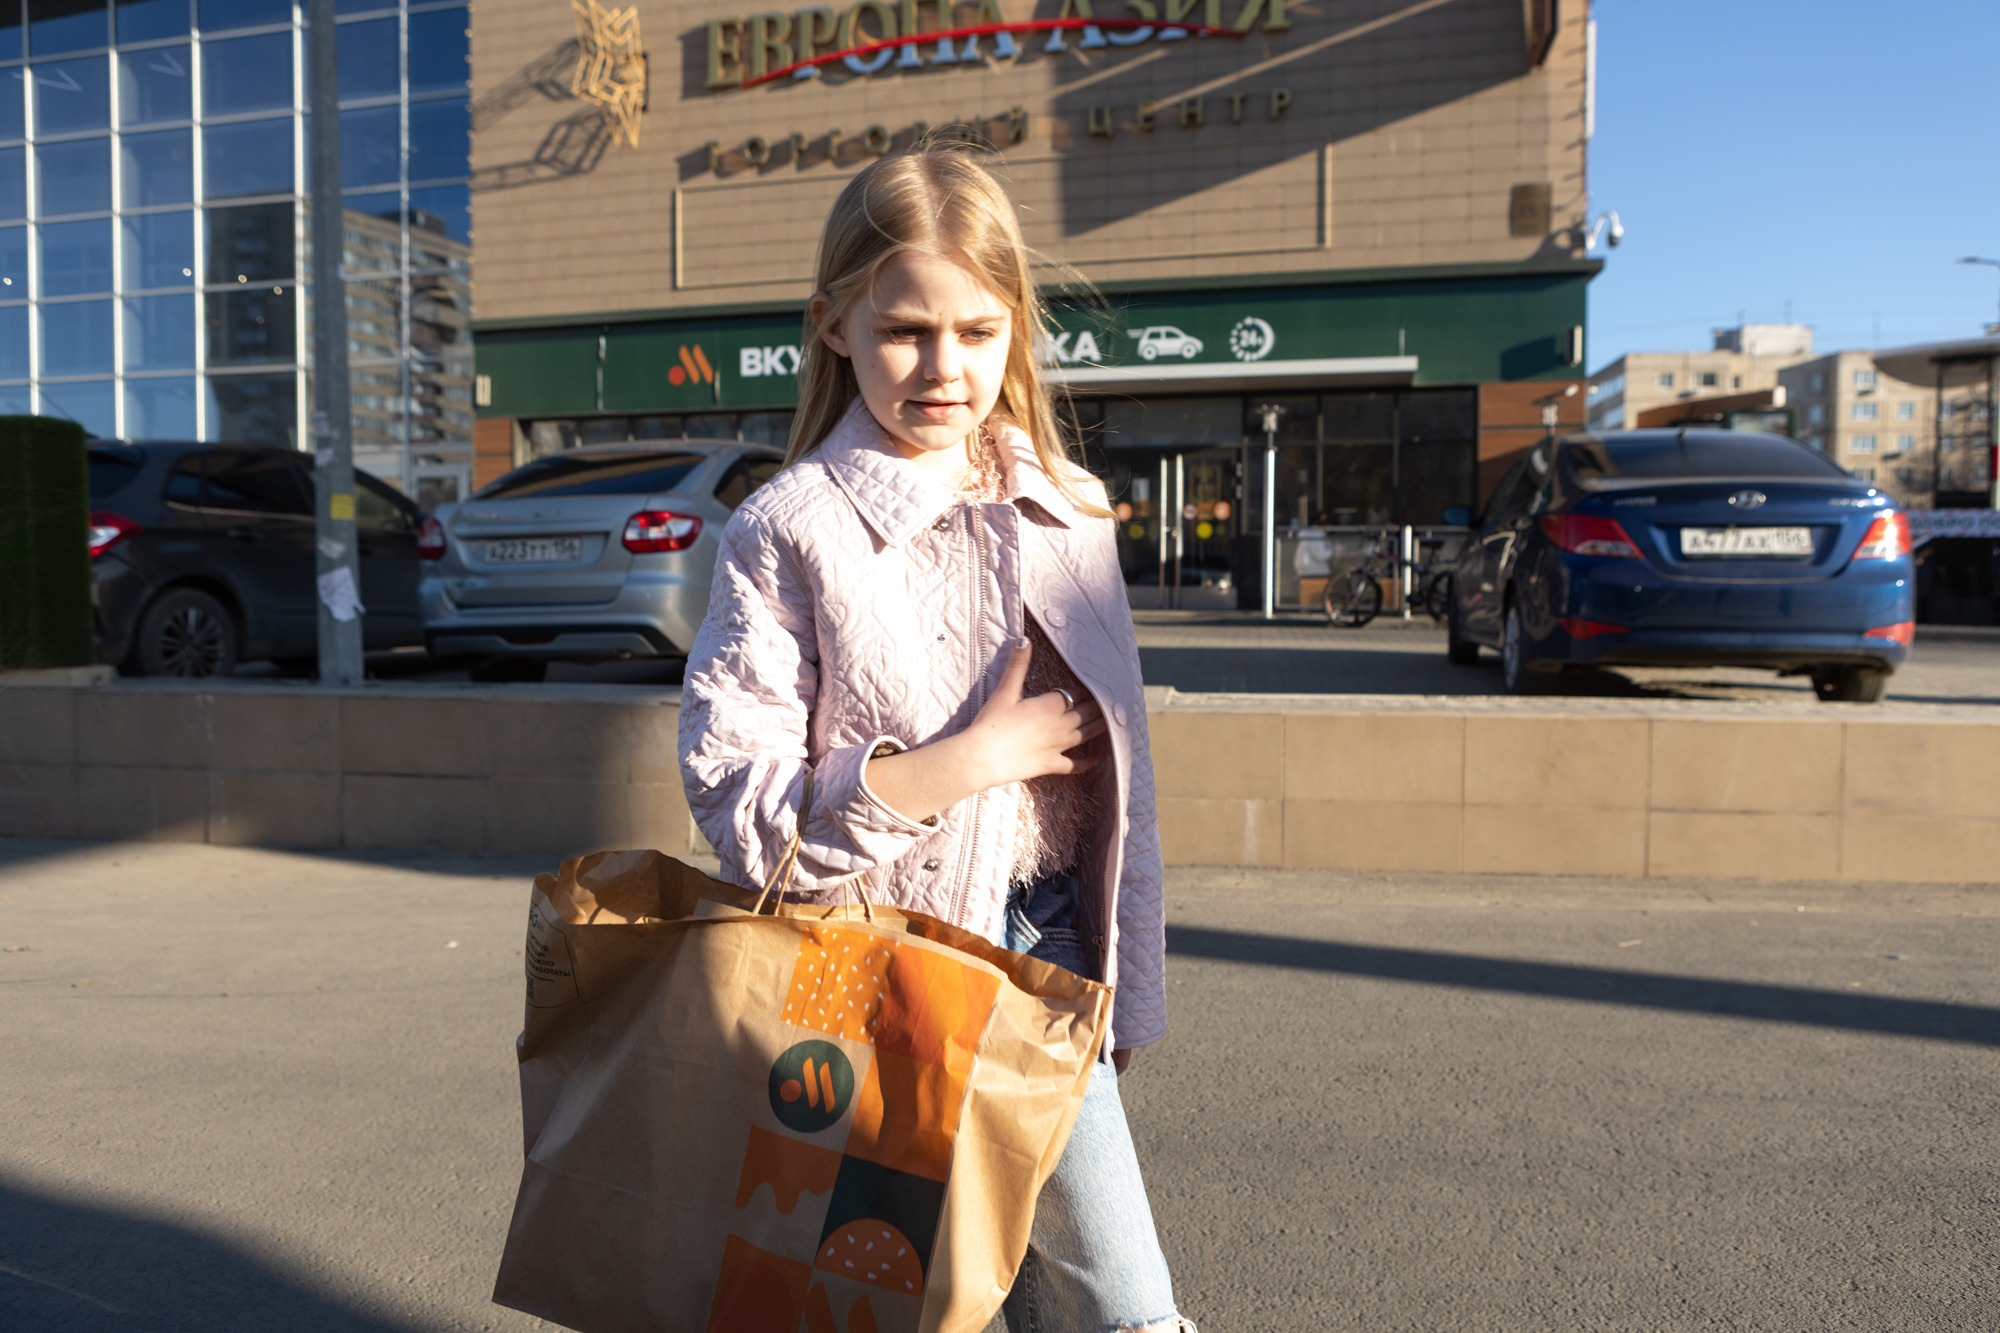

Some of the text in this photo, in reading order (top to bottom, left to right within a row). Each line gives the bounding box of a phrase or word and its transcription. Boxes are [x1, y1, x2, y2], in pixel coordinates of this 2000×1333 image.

[704, 0, 1021, 88] ЕВРОПА
[1088, 88, 1292, 138] ЦЕНТР
[740, 344, 803, 377] ВКУ
